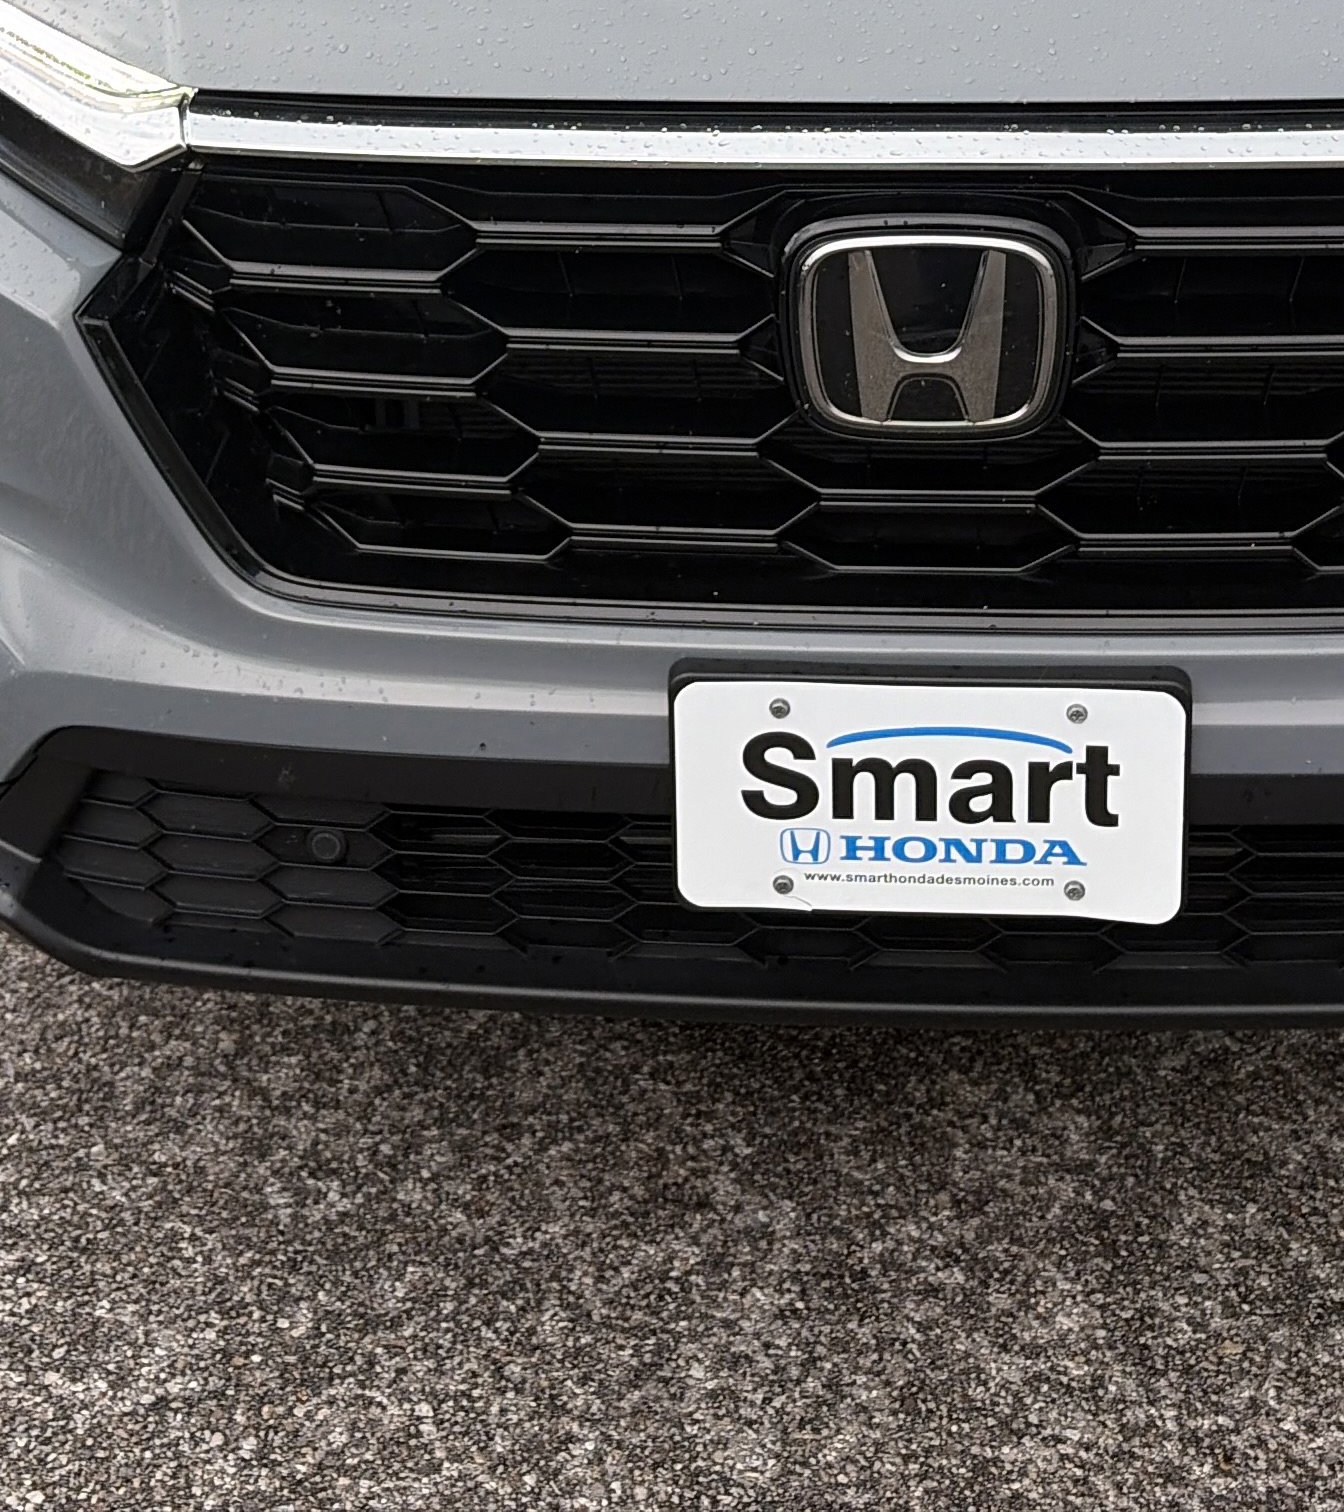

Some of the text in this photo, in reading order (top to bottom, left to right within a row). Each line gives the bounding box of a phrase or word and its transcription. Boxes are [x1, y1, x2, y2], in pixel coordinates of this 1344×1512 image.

[740, 730, 1121, 828] Smart
[839, 834, 1088, 866] HONDA
[803, 871, 1056, 888] www.smarthondadesmoines.com
